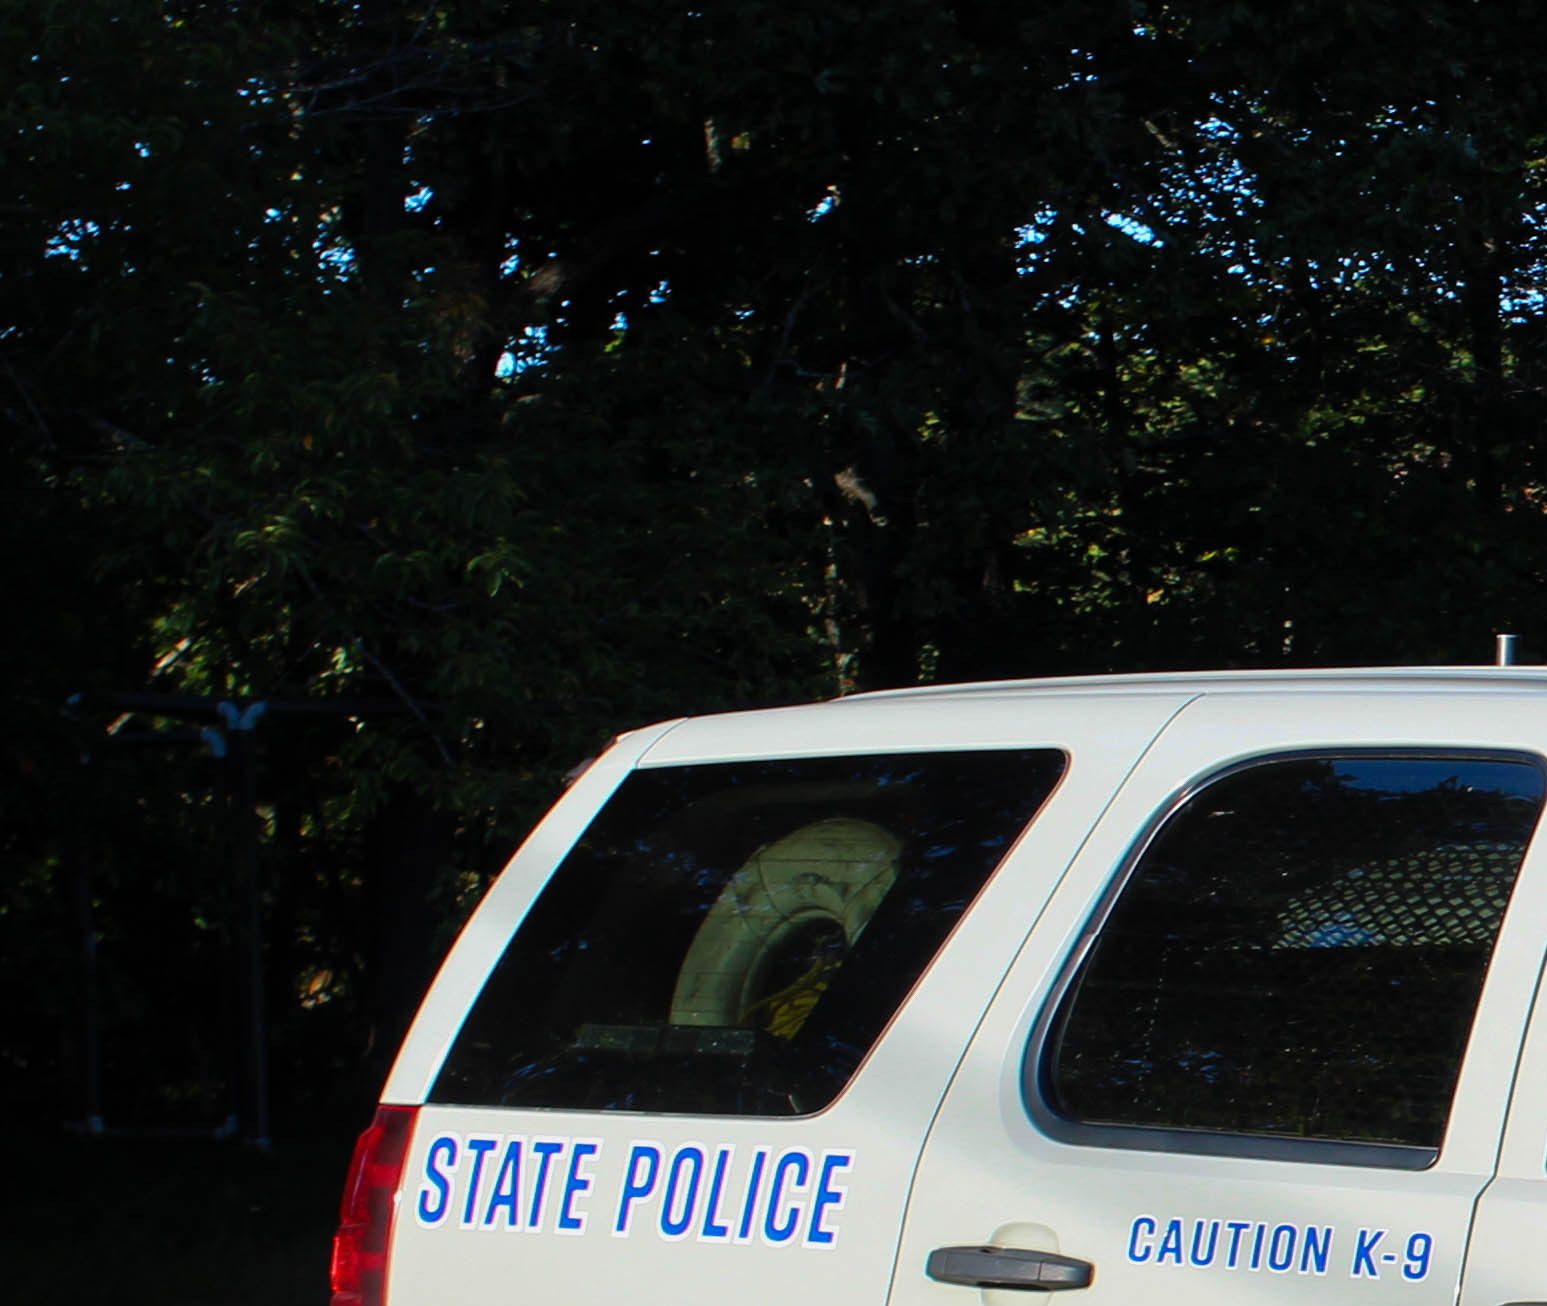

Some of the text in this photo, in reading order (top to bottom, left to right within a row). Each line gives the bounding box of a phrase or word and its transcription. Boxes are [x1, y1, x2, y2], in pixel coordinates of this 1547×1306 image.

[416, 1135, 850, 1245] STATE POLICE
[1127, 1216, 1433, 1280] CAUTION K-9
